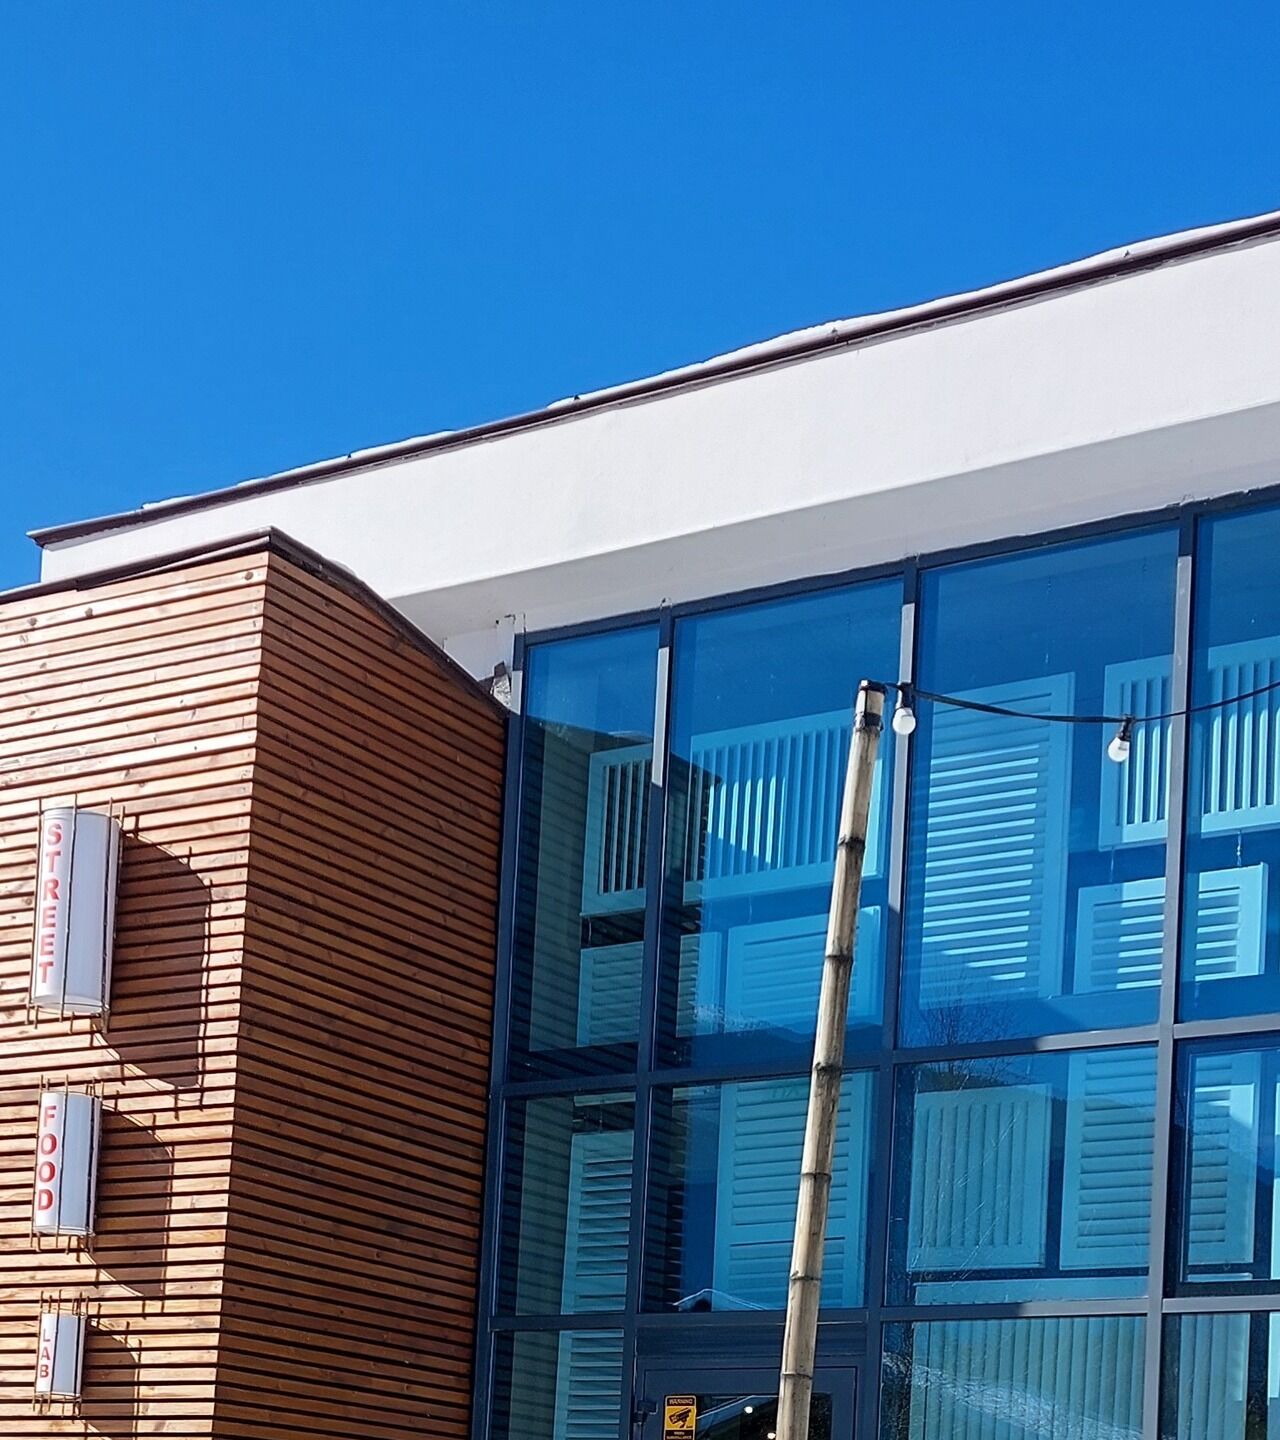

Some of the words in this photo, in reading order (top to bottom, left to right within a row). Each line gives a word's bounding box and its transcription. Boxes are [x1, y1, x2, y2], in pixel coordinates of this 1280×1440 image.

[38, 822, 64, 985] STREET
[37, 1104, 58, 1212] FOOD
[37, 1326, 52, 1380] LAB
